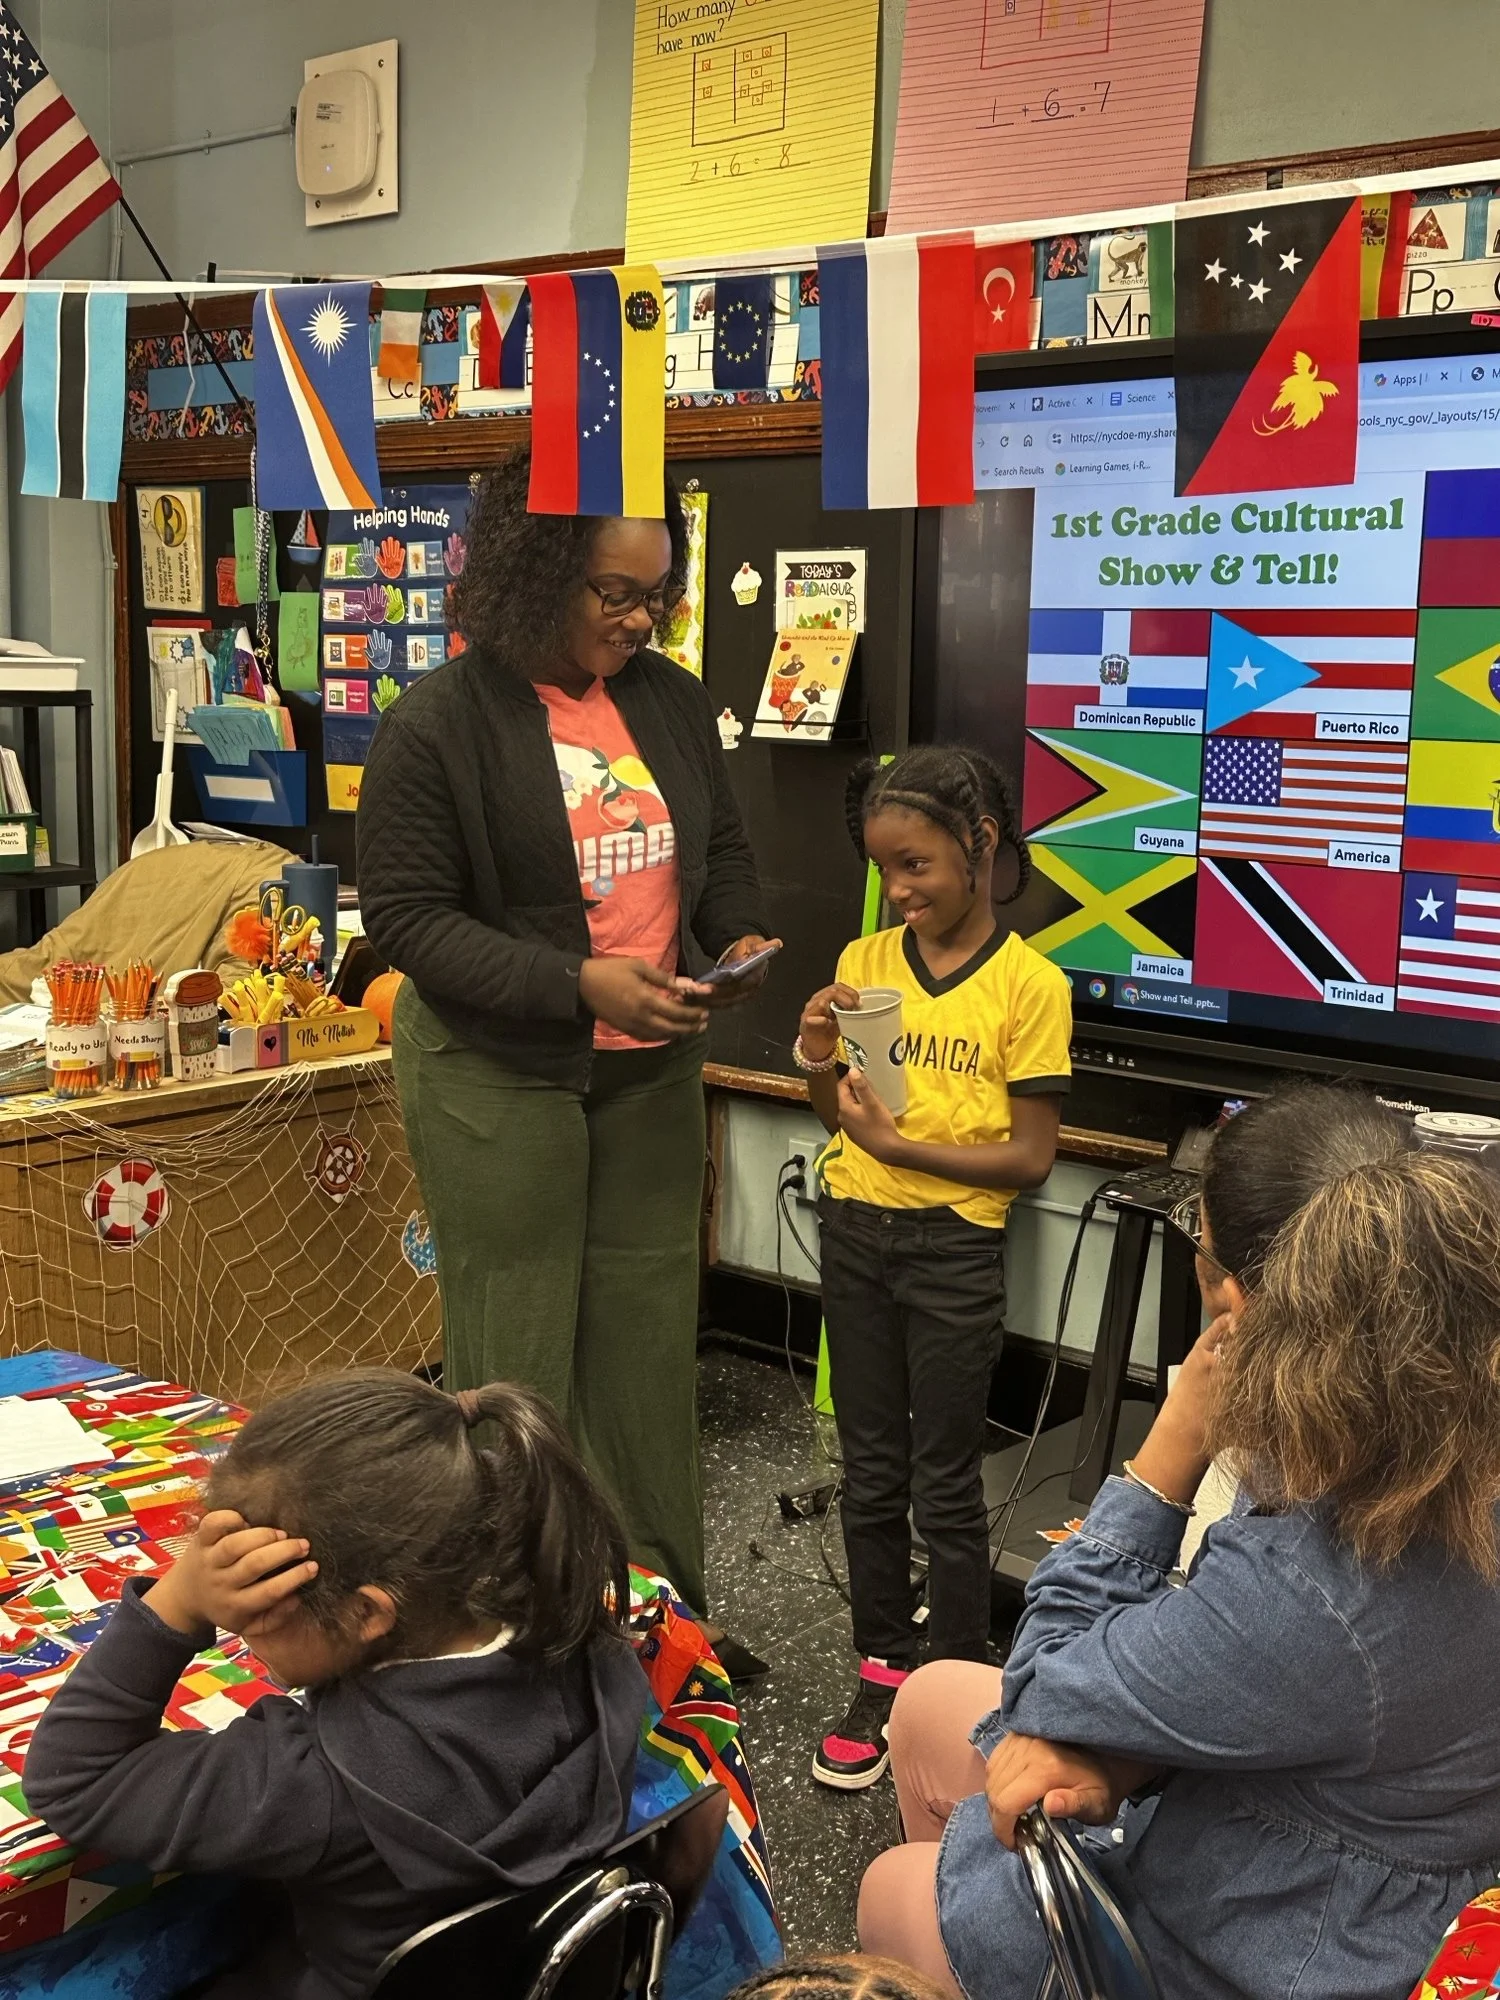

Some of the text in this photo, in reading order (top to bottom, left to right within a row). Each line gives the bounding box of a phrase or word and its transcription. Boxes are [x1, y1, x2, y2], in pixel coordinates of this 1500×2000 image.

[657, 0, 737, 29] How many
[656, 34, 683, 55] have
[1044, 88, 1060, 117] 6
[1094, 81, 1111, 112] 7
[730, 153, 741, 176] 6
[779, 144, 792, 168] 8
[1406, 251, 1428, 263] pizza
[1120, 275, 1148, 287] monkey
[1405, 269, 1454, 316] Pp
[1393, 375, 1417, 387] Apps
[1048, 399, 1071, 408] Active
[1127, 393, 1157, 403] Science
[994, 466, 1045, 477] Search Results
[1070, 463, 1102, 475] Learning
[353, 506, 450, 530] Helping Hands
[1050, 498, 1404, 538] 1st Grade Cultural
[1099, 553, 1339, 586] Show & Tell!
[1079, 711, 1197, 728] Dominican Republic
[1322, 719, 1400, 736] Puerto Rico
[346, 783, 359, 797] Jo
[1139, 833, 1184, 849] Guyana
[573, 822, 675, 885] UMA
[1334, 848, 1391, 865] America
[1136, 960, 1184, 977] Jamaica
[1140, 989, 1161, 1000] Show
[1162, 993, 1177, 1003] and
[1179, 994, 1192, 1005] Tell
[1329, 986, 1384, 1004] Trinidad
[49, 1041, 78, 1054] Ready
[80, 1042, 91, 1051] to
[114, 1035, 140, 1045] Needs
[904, 1032, 981, 1077] MAICA
[1375, 1095, 1431, 1113] Promethean
